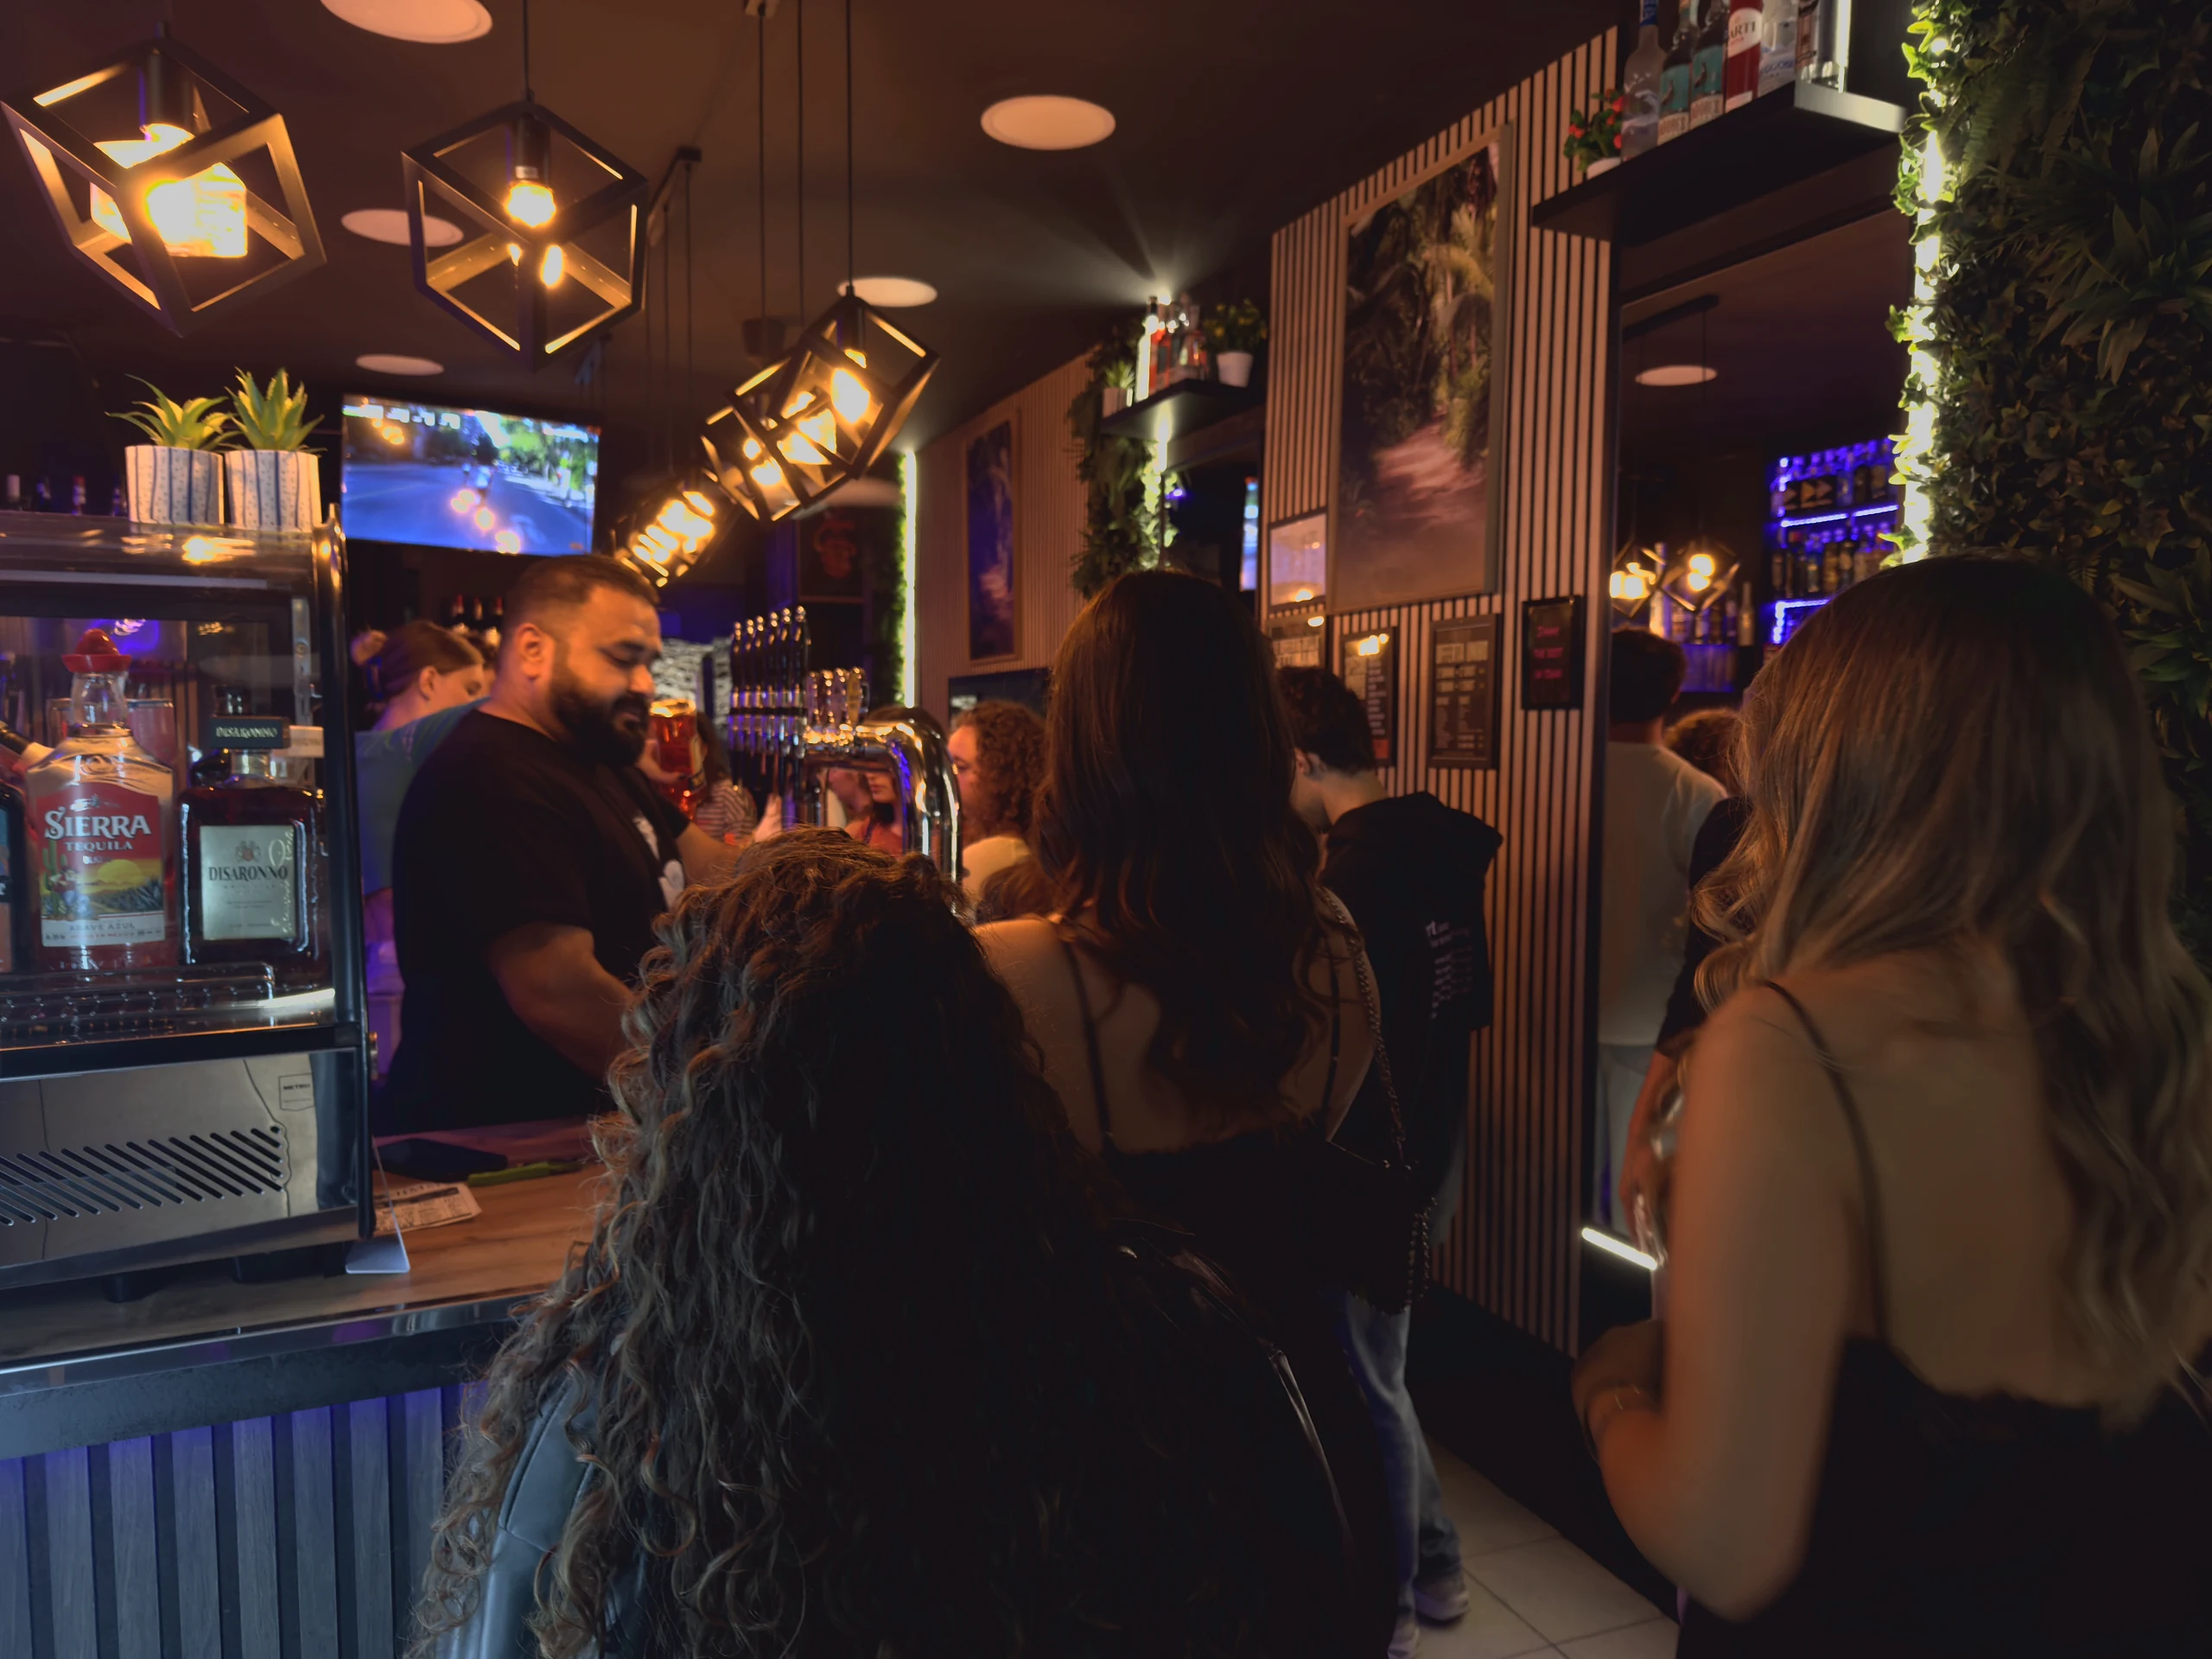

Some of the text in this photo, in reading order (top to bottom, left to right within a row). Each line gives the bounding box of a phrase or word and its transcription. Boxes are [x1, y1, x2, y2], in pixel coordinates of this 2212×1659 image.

[44, 806, 152, 840] SIERRA
[65, 841, 134, 853] TEQUILA
[208, 866, 289, 881] DISARONNO
